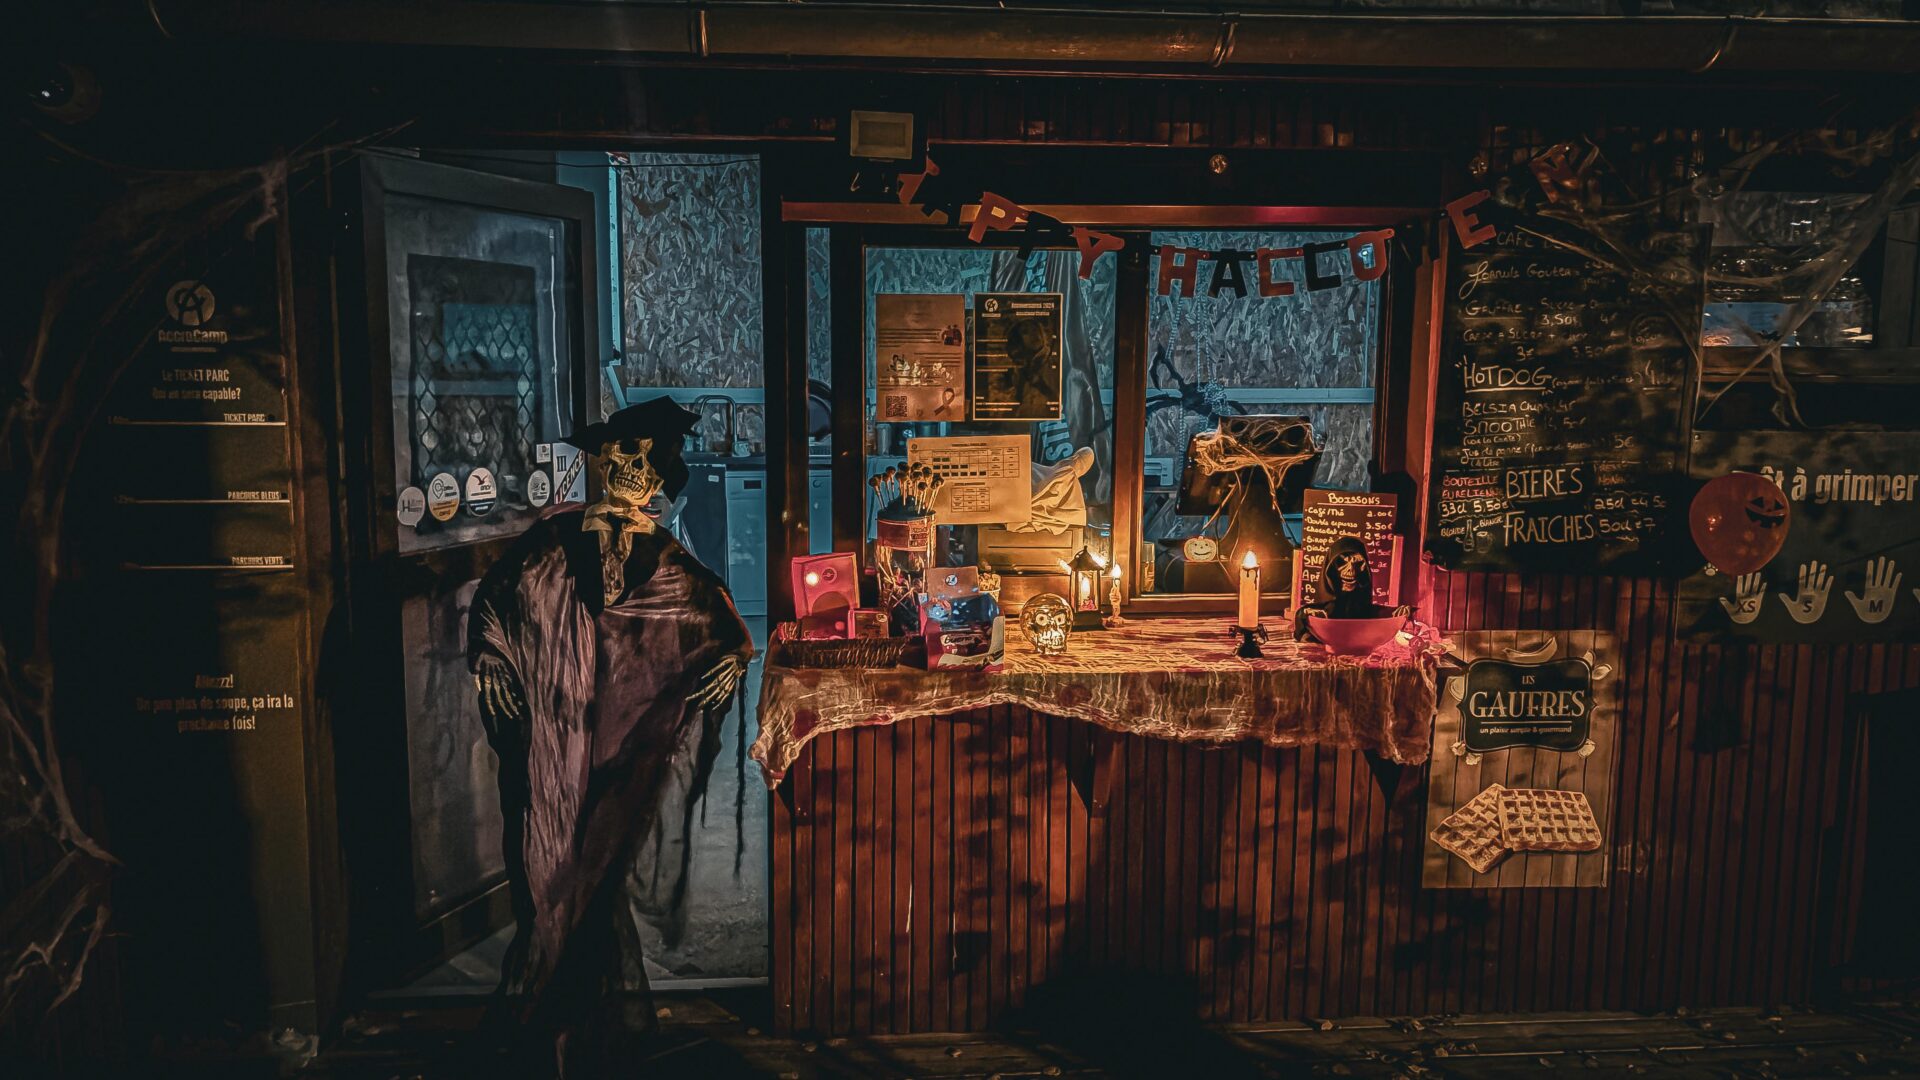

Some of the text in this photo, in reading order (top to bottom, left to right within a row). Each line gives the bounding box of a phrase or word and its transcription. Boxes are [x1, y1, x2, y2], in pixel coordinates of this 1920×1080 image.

[174, 368, 203, 382] TICKET
[206, 368, 230, 382] PARC
[202, 387, 242, 403] capable?
[1790, 466, 1808, 501] à
[1815, 468, 1920, 507] grimper
[1735, 600, 1757, 614] XS
[1802, 600, 1813, 613] S
[1868, 600, 1884, 614] M
[216, 698, 250, 711] soupe,
[252, 698, 265, 712] ça
[267, 694, 282, 708] ira
[284, 693, 294, 708] la
[1469, 690, 1586, 718] GAUFRES
[232, 715, 256, 730] fois!
